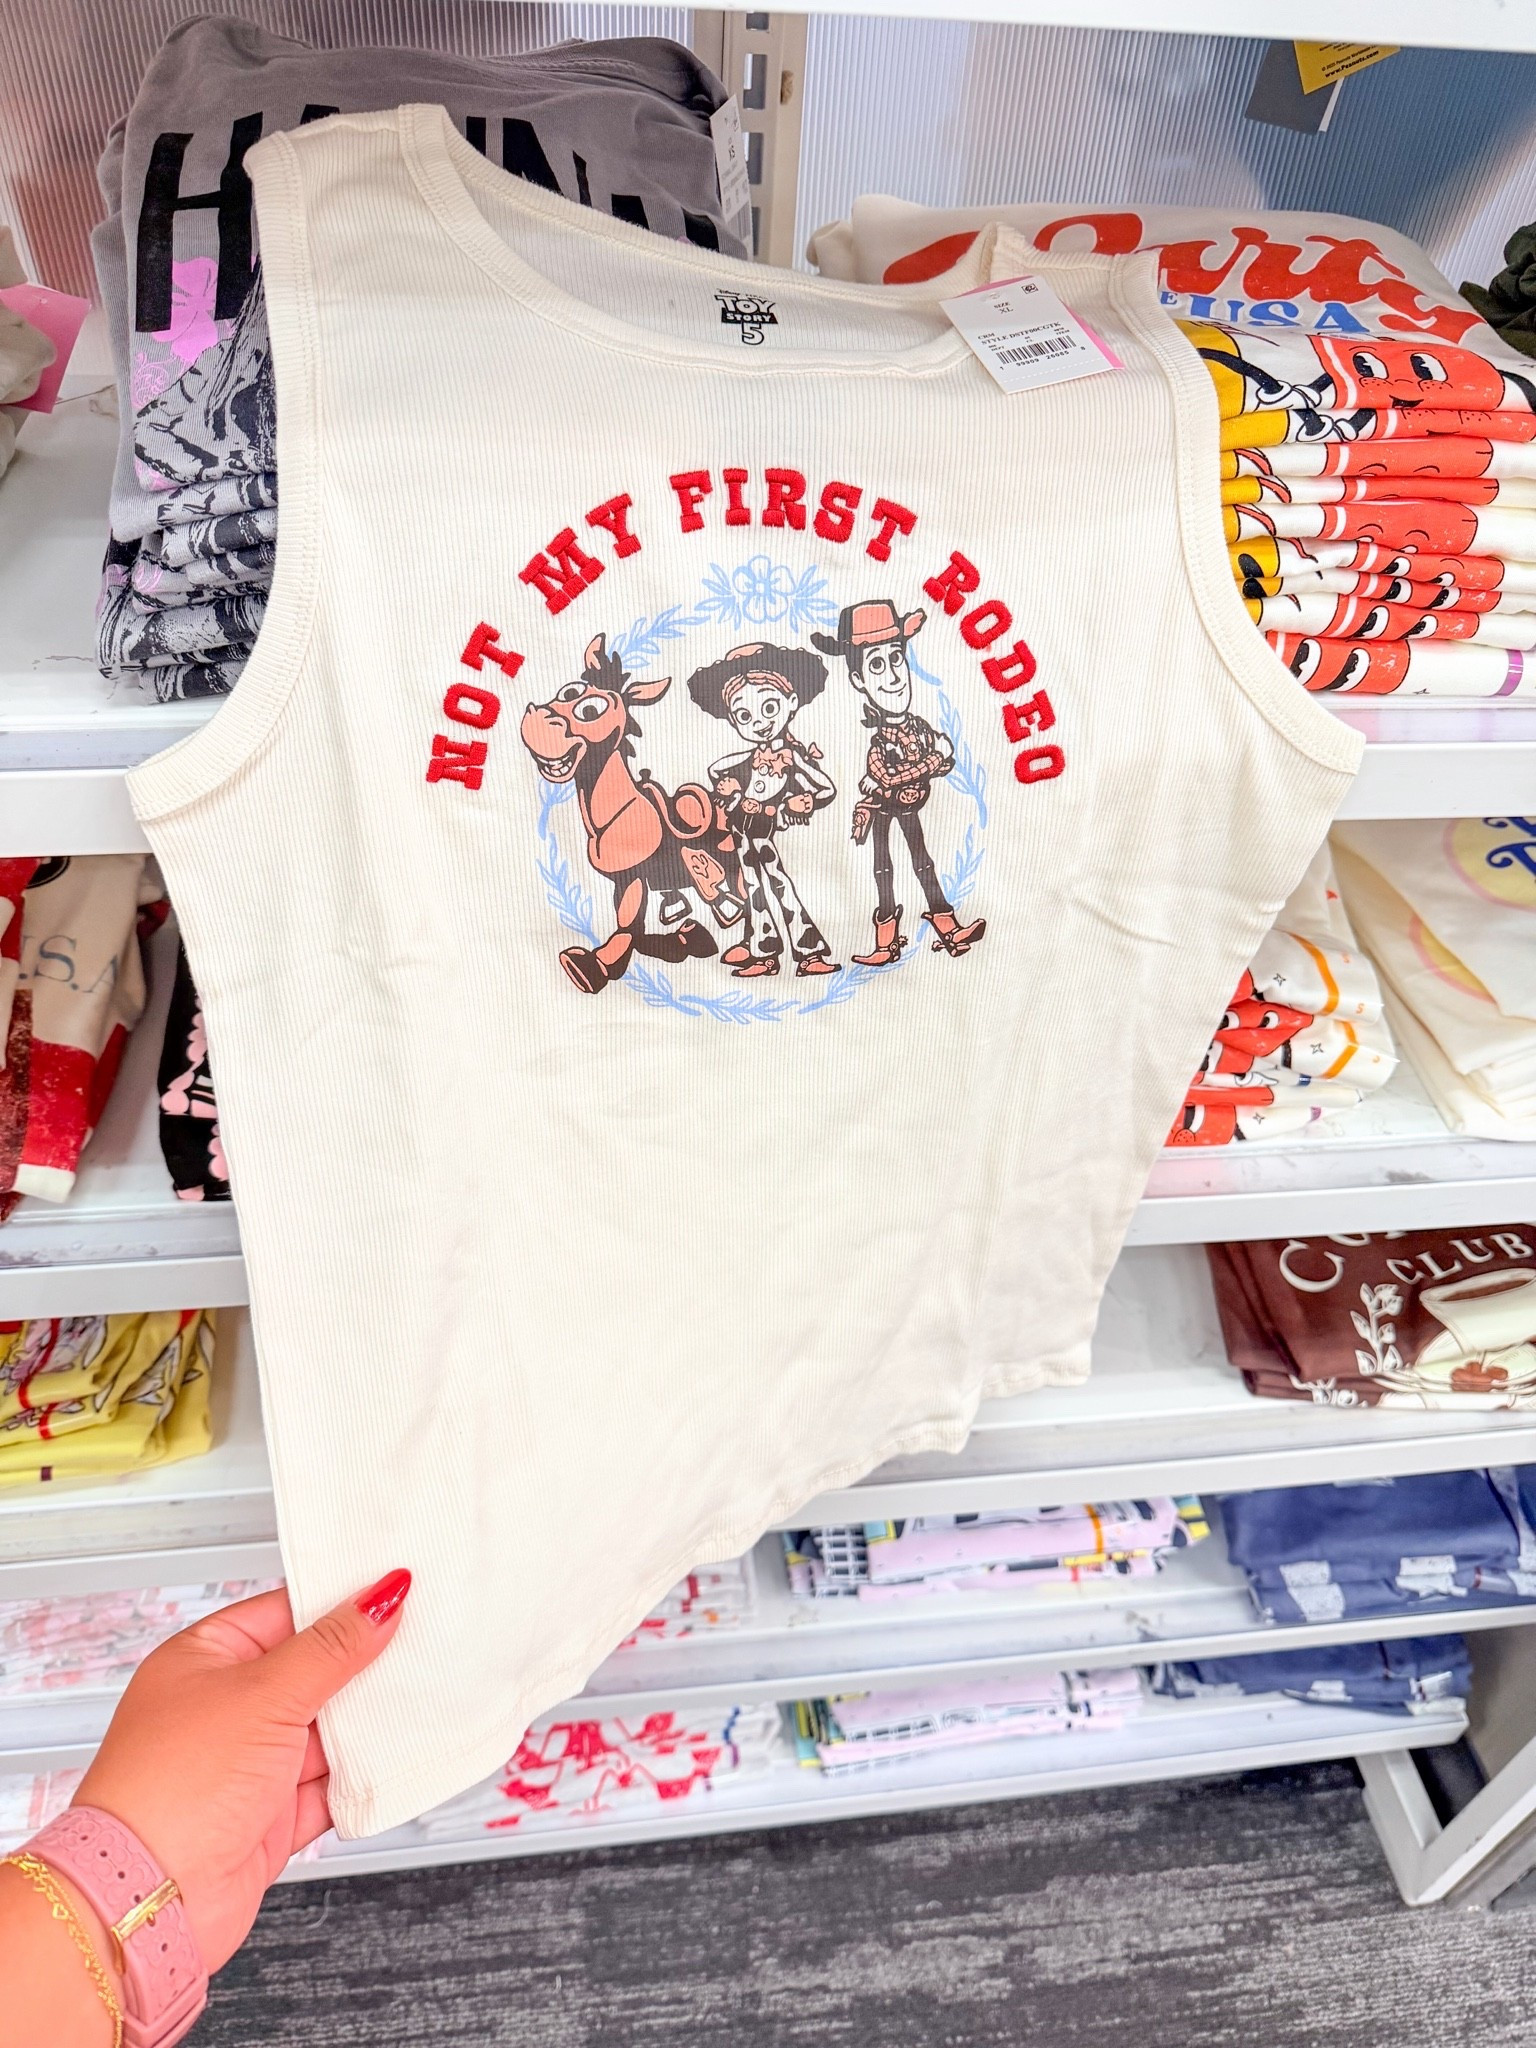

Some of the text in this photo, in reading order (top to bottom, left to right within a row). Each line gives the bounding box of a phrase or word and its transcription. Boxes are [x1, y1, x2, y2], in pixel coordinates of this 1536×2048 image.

[1325, 50, 1379, 78] www.Peanuts.com
[714, 294, 776, 315] TOY
[725, 312, 773, 323] STORY
[1188, 294, 1370, 333] USA
[741, 321, 765, 346] 5
[981, 335, 1009, 345] STYLE
[426, 467, 1066, 791] NOT MY FIRST RODEO
[1386, 1232, 1535, 1285] CLUB
